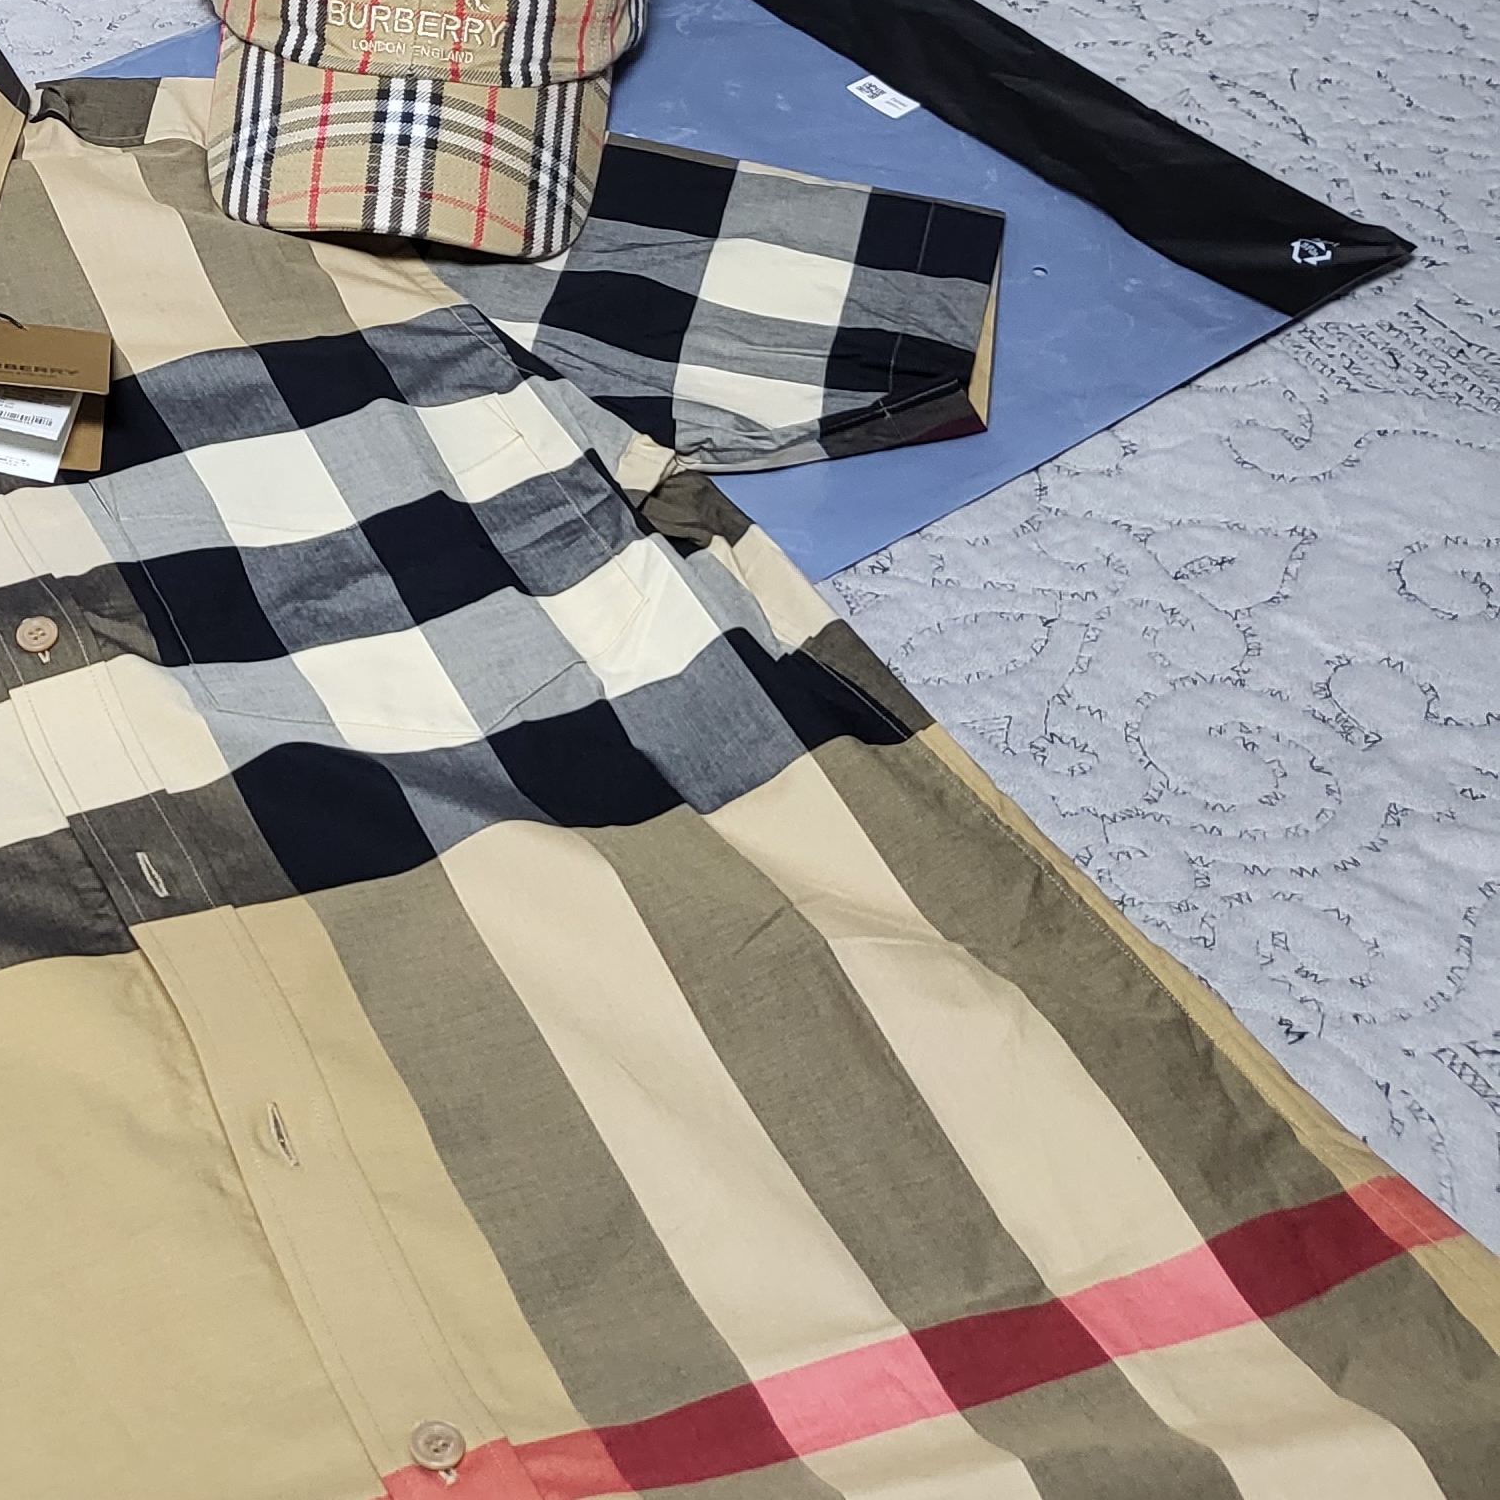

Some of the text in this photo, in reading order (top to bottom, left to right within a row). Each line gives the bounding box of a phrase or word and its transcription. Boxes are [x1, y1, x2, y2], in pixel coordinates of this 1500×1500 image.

[327, 0, 510, 47] BURBERRY
[352, 39, 475, 64] LONDON ENGLAND
